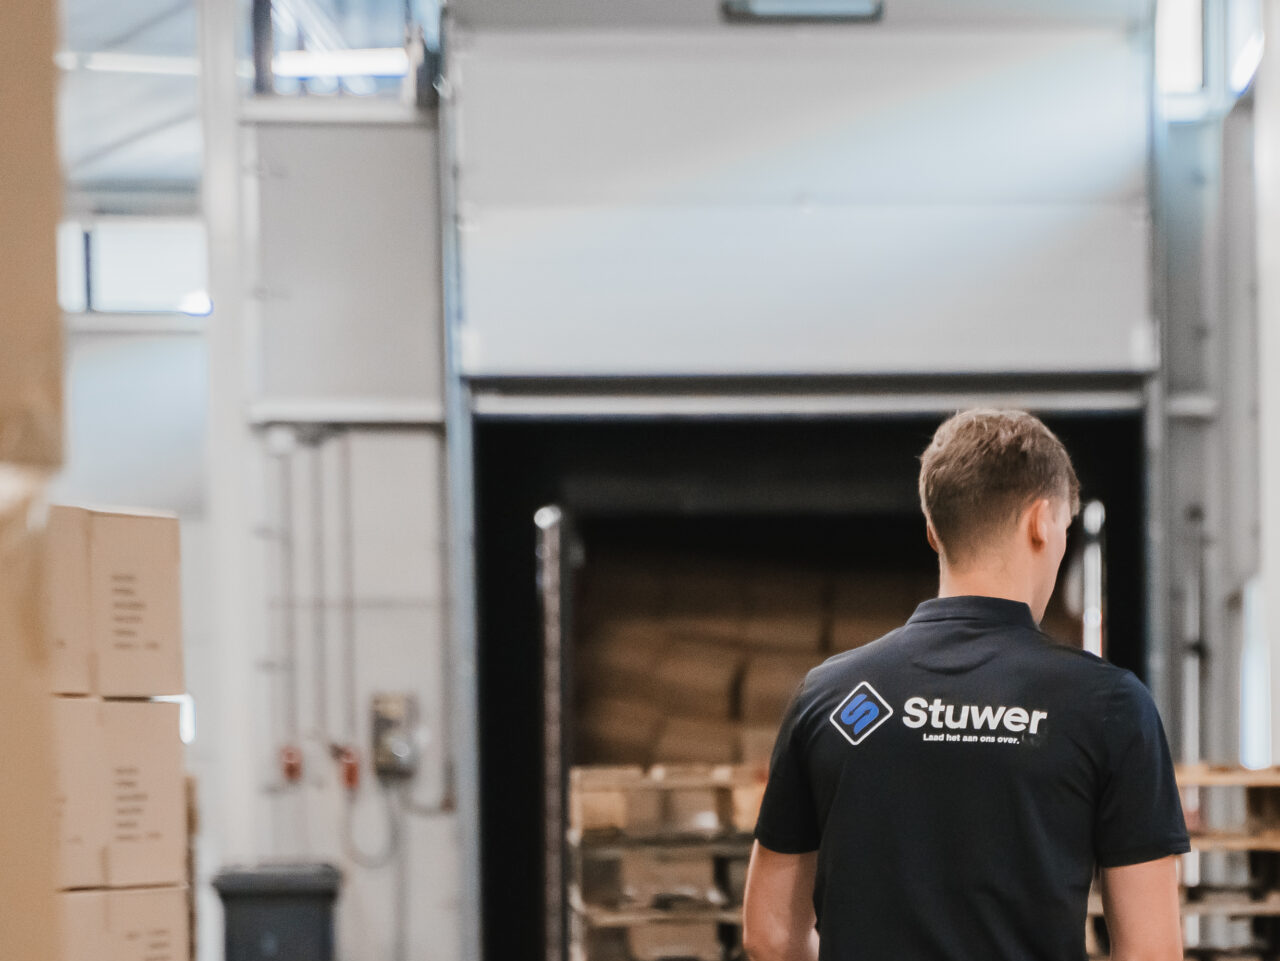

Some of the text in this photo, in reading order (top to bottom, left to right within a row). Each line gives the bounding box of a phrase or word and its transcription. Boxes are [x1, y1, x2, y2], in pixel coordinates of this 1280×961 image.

[902, 696, 1048, 734] Stuwer
[923, 733, 1020, 745] Laad het aan ons over.
